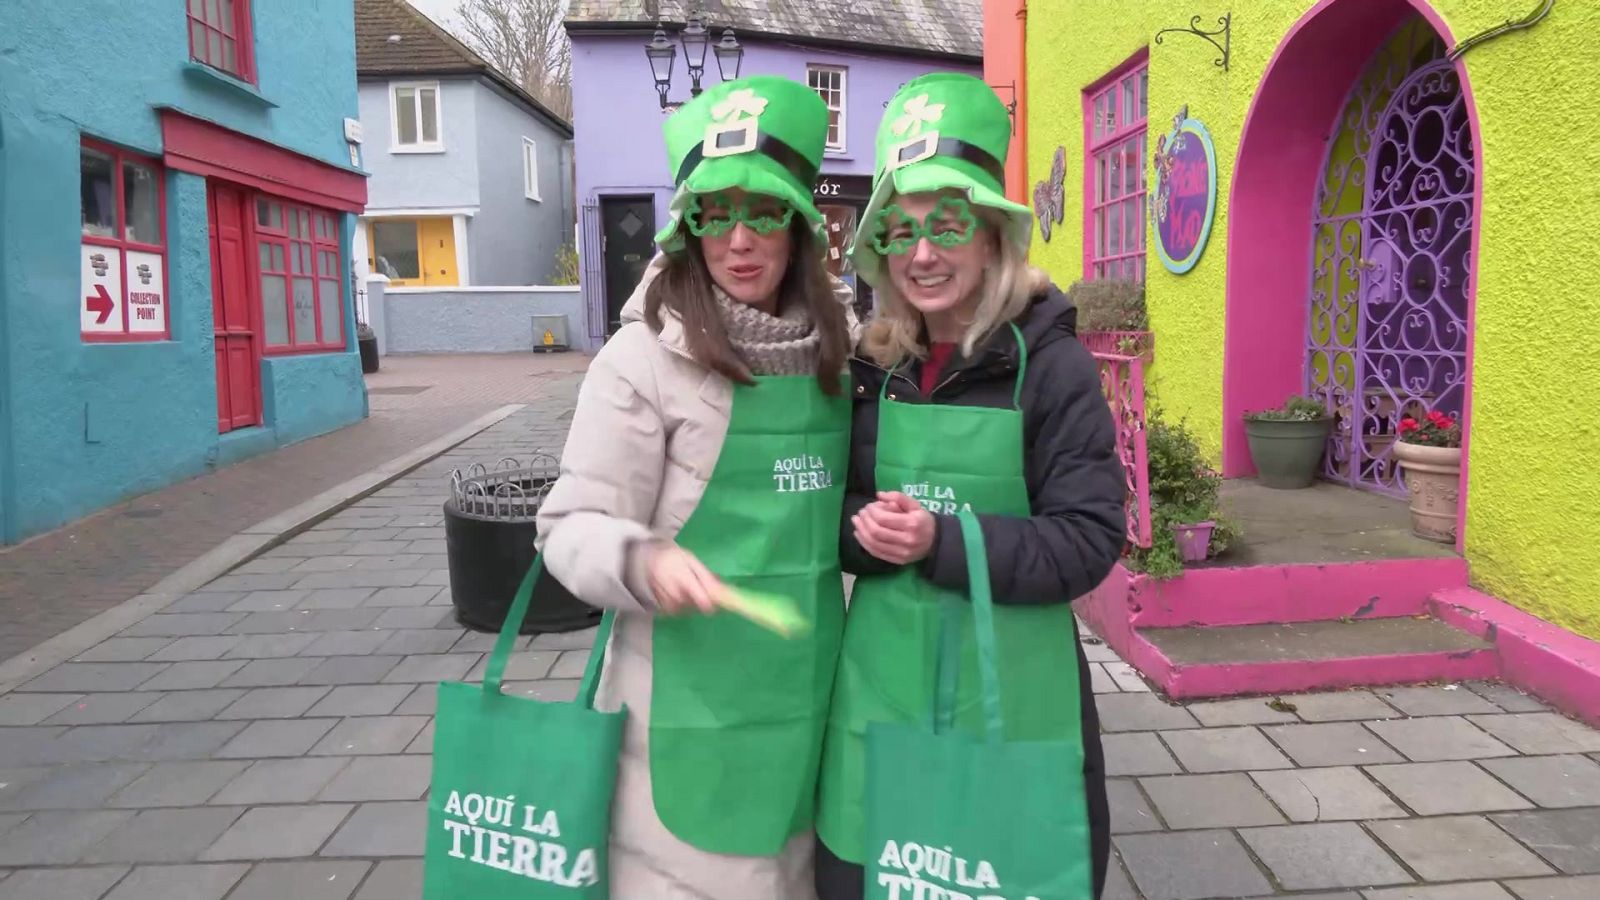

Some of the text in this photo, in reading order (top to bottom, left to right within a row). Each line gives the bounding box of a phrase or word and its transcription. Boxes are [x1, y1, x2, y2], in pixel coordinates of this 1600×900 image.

[814, 178, 841, 195] ór
[130, 291, 160, 305] COLLECTION
[136, 307, 155, 320] POINT
[773, 453, 824, 473] AQUÍ LA
[773, 469, 833, 492] TIERRA
[901, 481, 956, 500] QUÍ LA
[444, 790, 561, 838] AQUÍ LA
[443, 819, 600, 888] TIERRA
[878, 839, 1001, 889] AQUÍ LA
